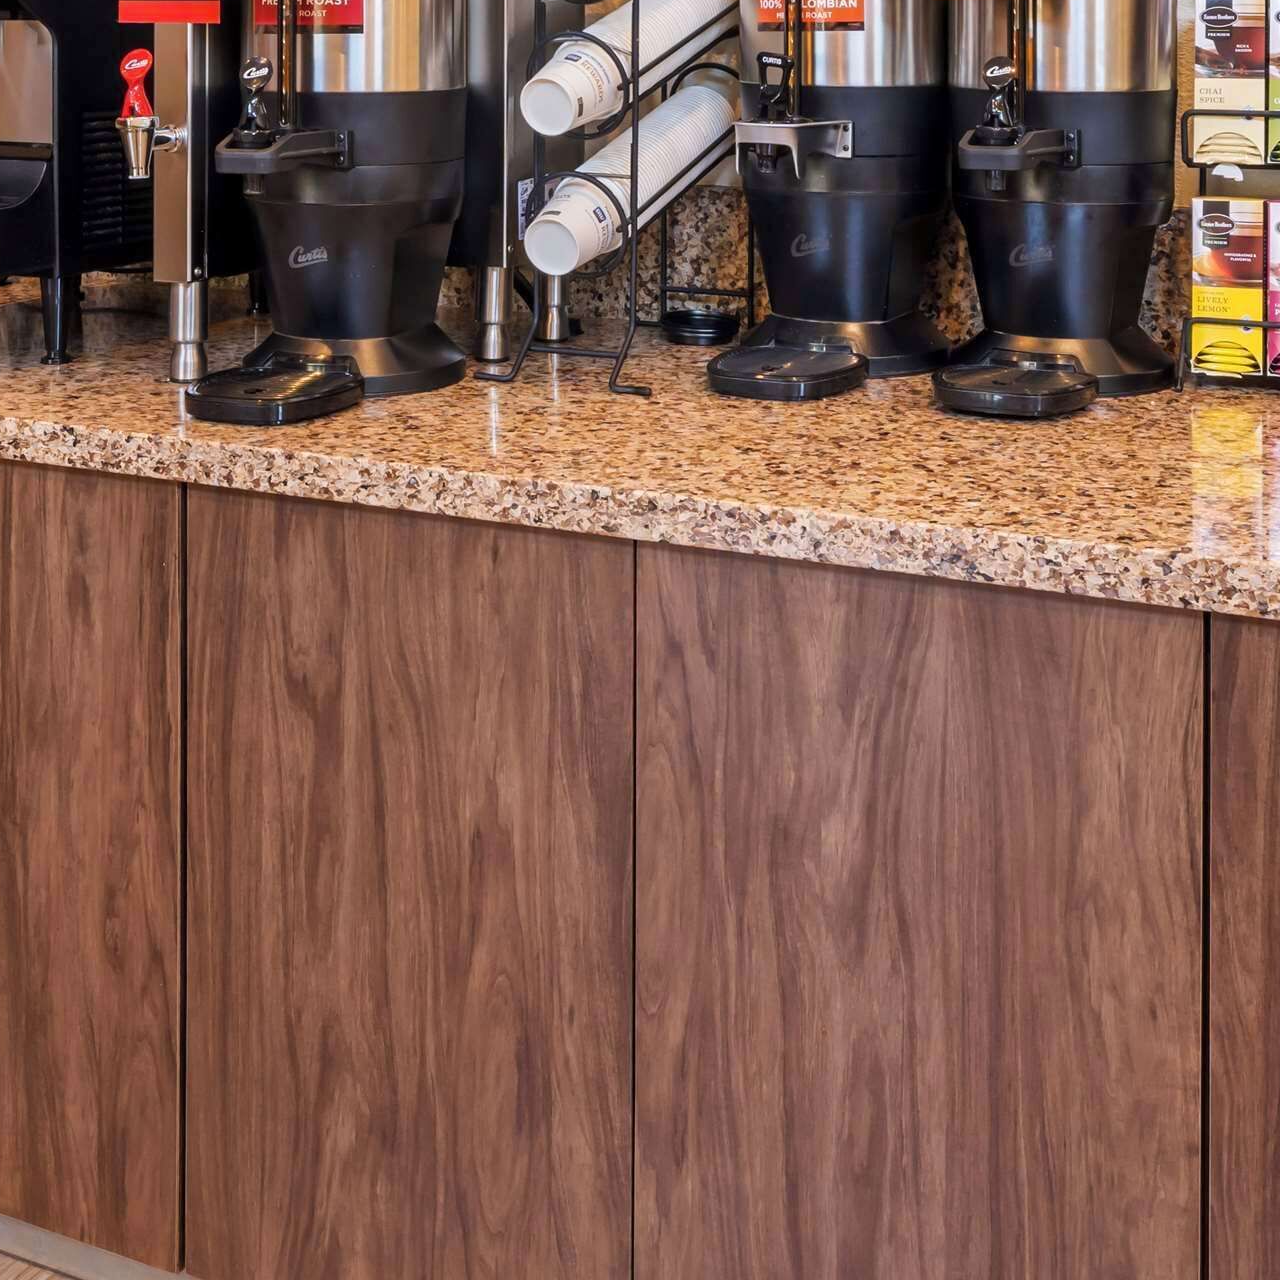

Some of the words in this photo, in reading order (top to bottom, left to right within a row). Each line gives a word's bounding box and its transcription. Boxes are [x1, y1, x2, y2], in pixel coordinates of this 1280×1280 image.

[760, 0, 782, 9] 100%
[806, 11, 833, 19] ROAST
[1199, 87, 1223, 95] CHAI
[288, 246, 328, 269] Curtis
[1197, 296, 1229, 304] LIVELY
